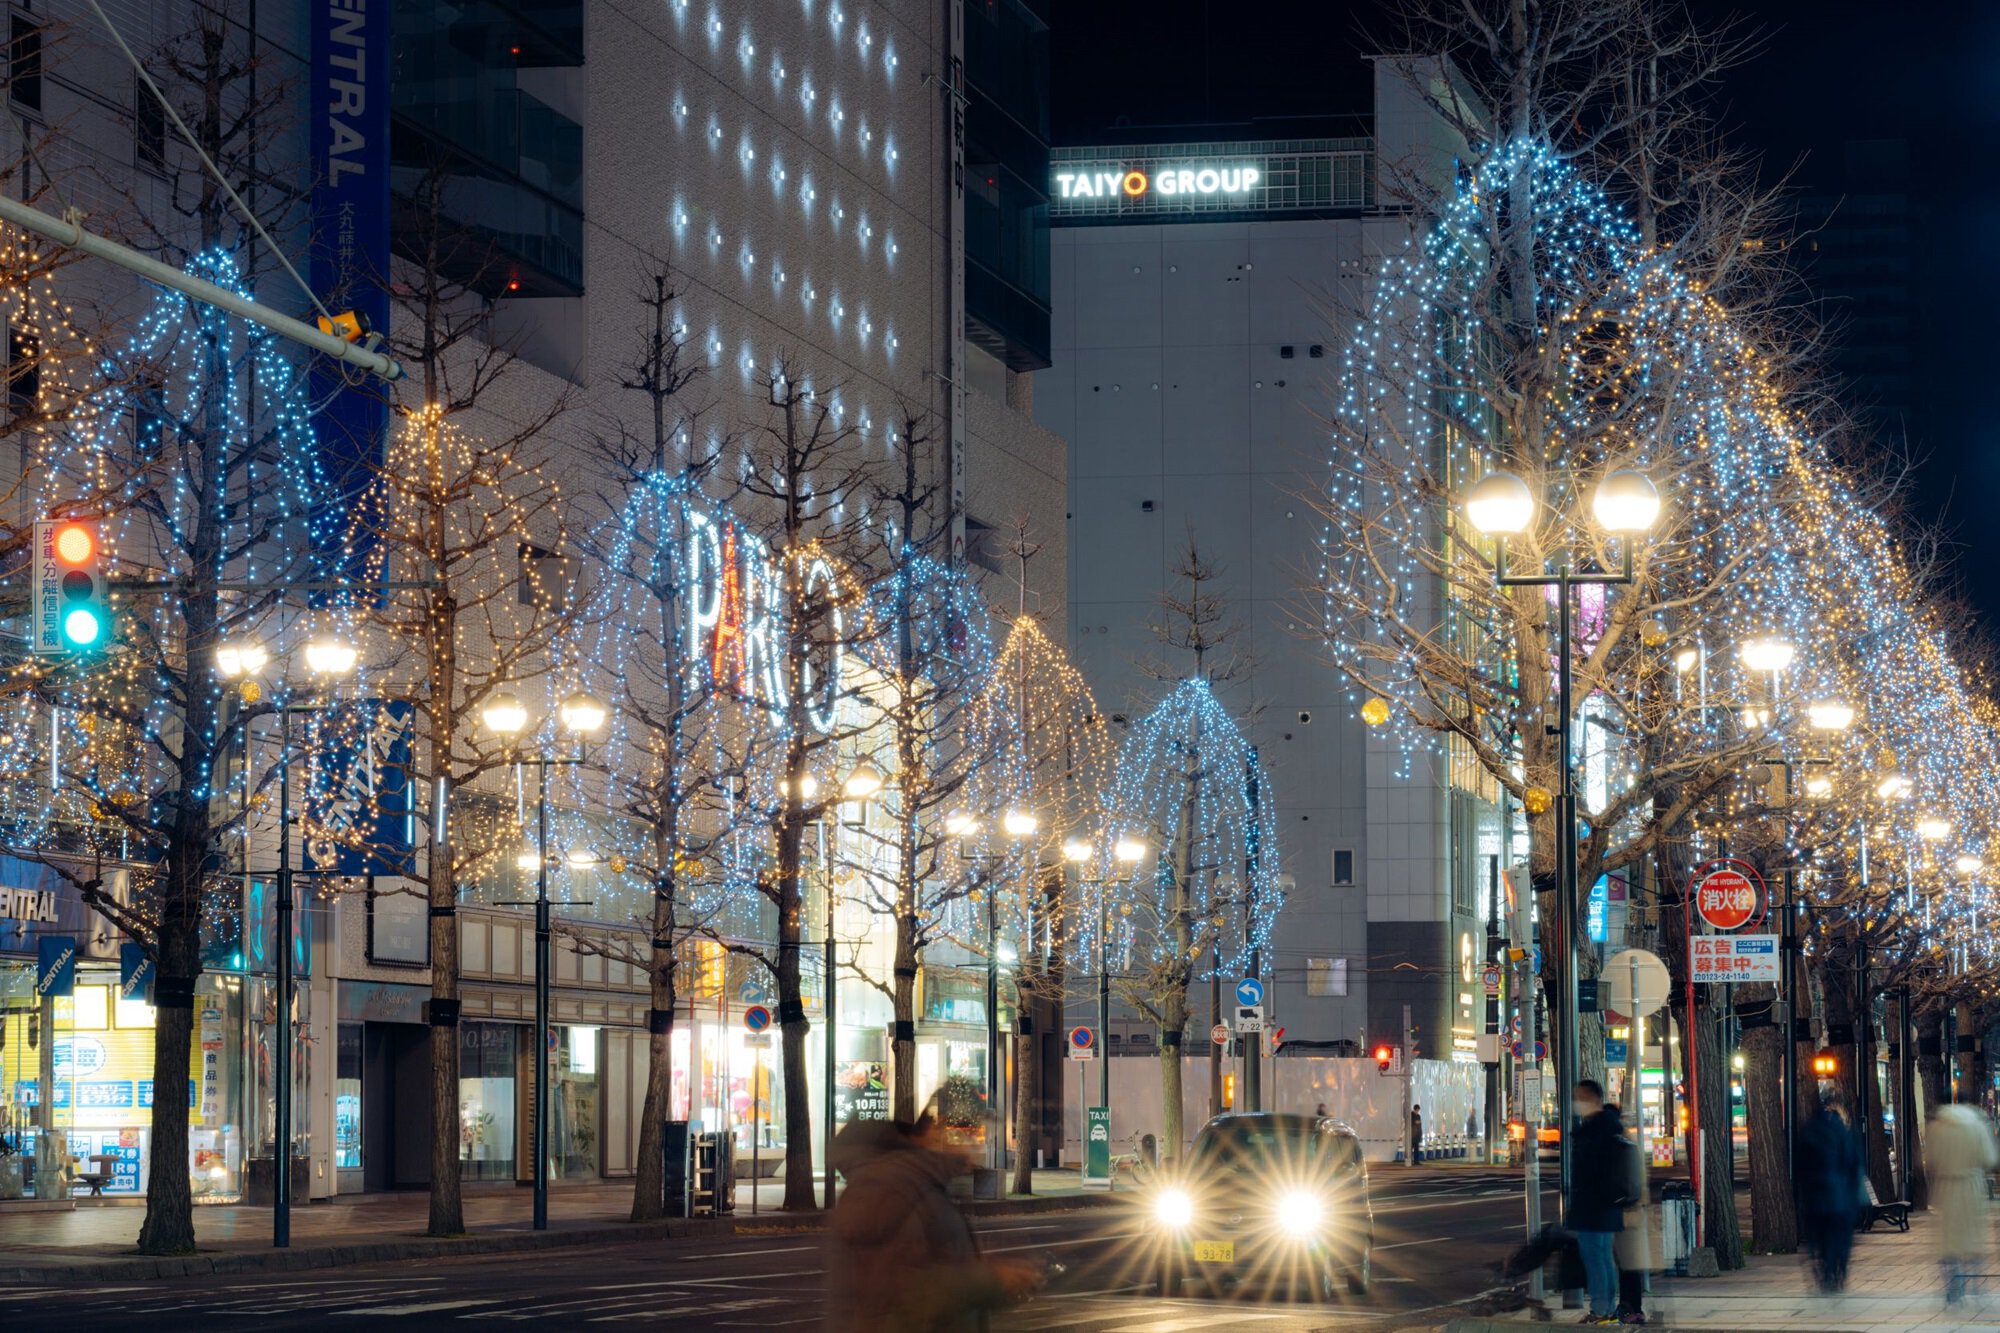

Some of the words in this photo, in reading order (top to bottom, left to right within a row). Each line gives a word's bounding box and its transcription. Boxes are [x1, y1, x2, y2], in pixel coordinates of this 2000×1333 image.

[1057, 172, 1147, 197] TAIYO
[1156, 168, 1259, 195] GROUP
[1703, 889, 1751, 912] 消火栓
[1695, 940, 1732, 955] 広告
[39, 948, 73, 993] CENTRAL
[1695, 957, 1752, 973] 募集中
[1089, 1111, 1109, 1120] TAXI
